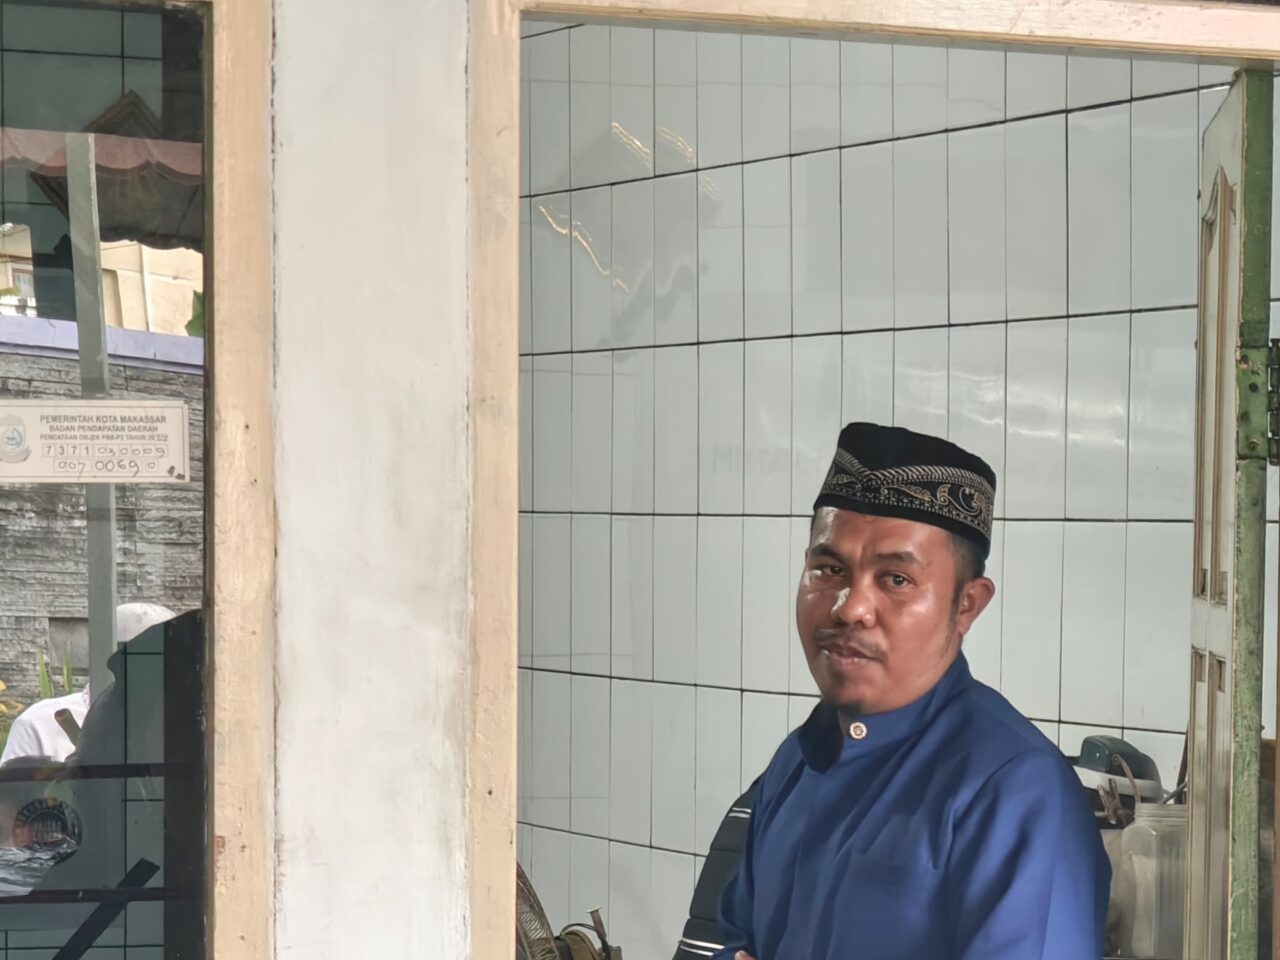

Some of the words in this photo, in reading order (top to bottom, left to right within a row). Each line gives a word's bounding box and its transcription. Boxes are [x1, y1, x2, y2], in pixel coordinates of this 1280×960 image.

[40, 415, 94, 424] PEMERINTAH
[95, 415, 118, 424] KOTA
[120, 415, 167, 424] MAKASSAR
[49, 425, 75, 433] BADAN
[77, 425, 126, 433] PENDAPATAN
[127, 425, 158, 433] DAERAH
